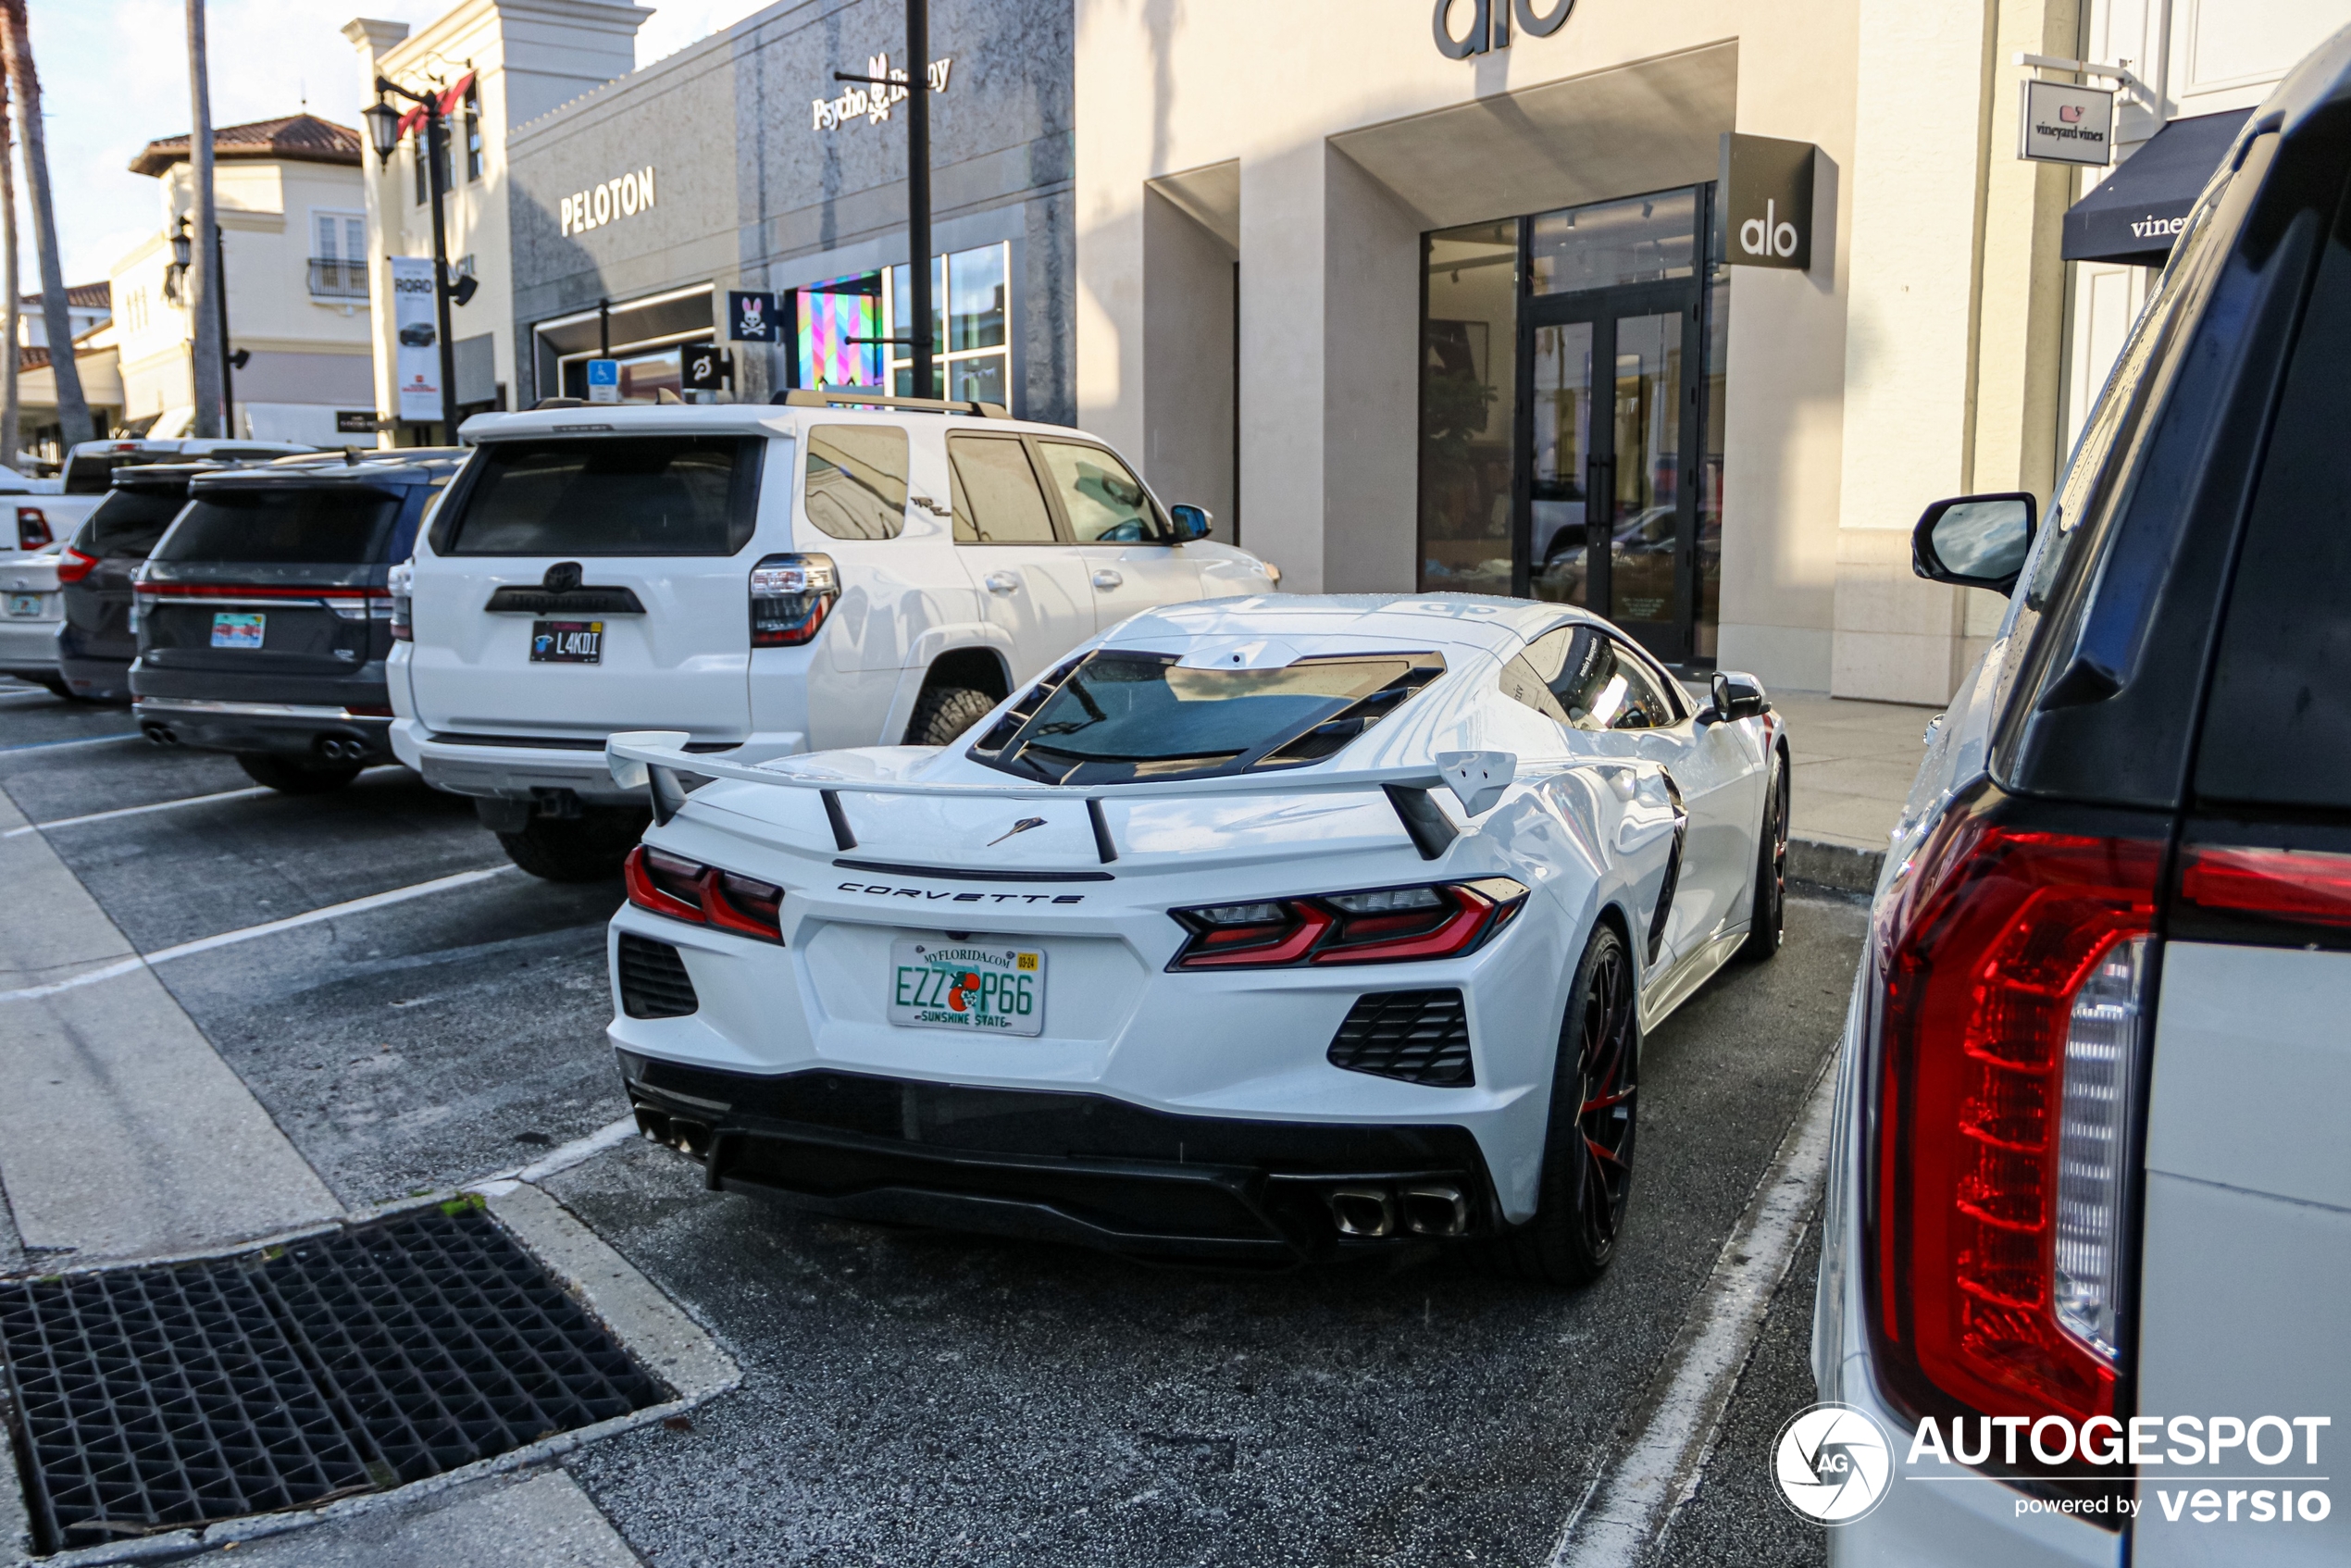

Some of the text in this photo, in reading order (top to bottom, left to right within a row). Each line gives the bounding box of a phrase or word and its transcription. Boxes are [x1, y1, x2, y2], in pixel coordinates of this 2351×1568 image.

[812, 57, 952, 131] Psycho Bny
[2036, 121, 2103, 142] vineyard vines
[560, 166, 654, 237] PELOTON
[1740, 198, 1797, 257] alo
[2131, 214, 2188, 238] vine
[838, 882, 1085, 904] CORVETTE
[925, 949, 1011, 969] MYFLORIDA.COM
[1018, 956, 1035, 968] 03-24
[895, 965, 1034, 1015] EZZ P66
[920, 1010, 1006, 1028] SUNSHINE STATE
